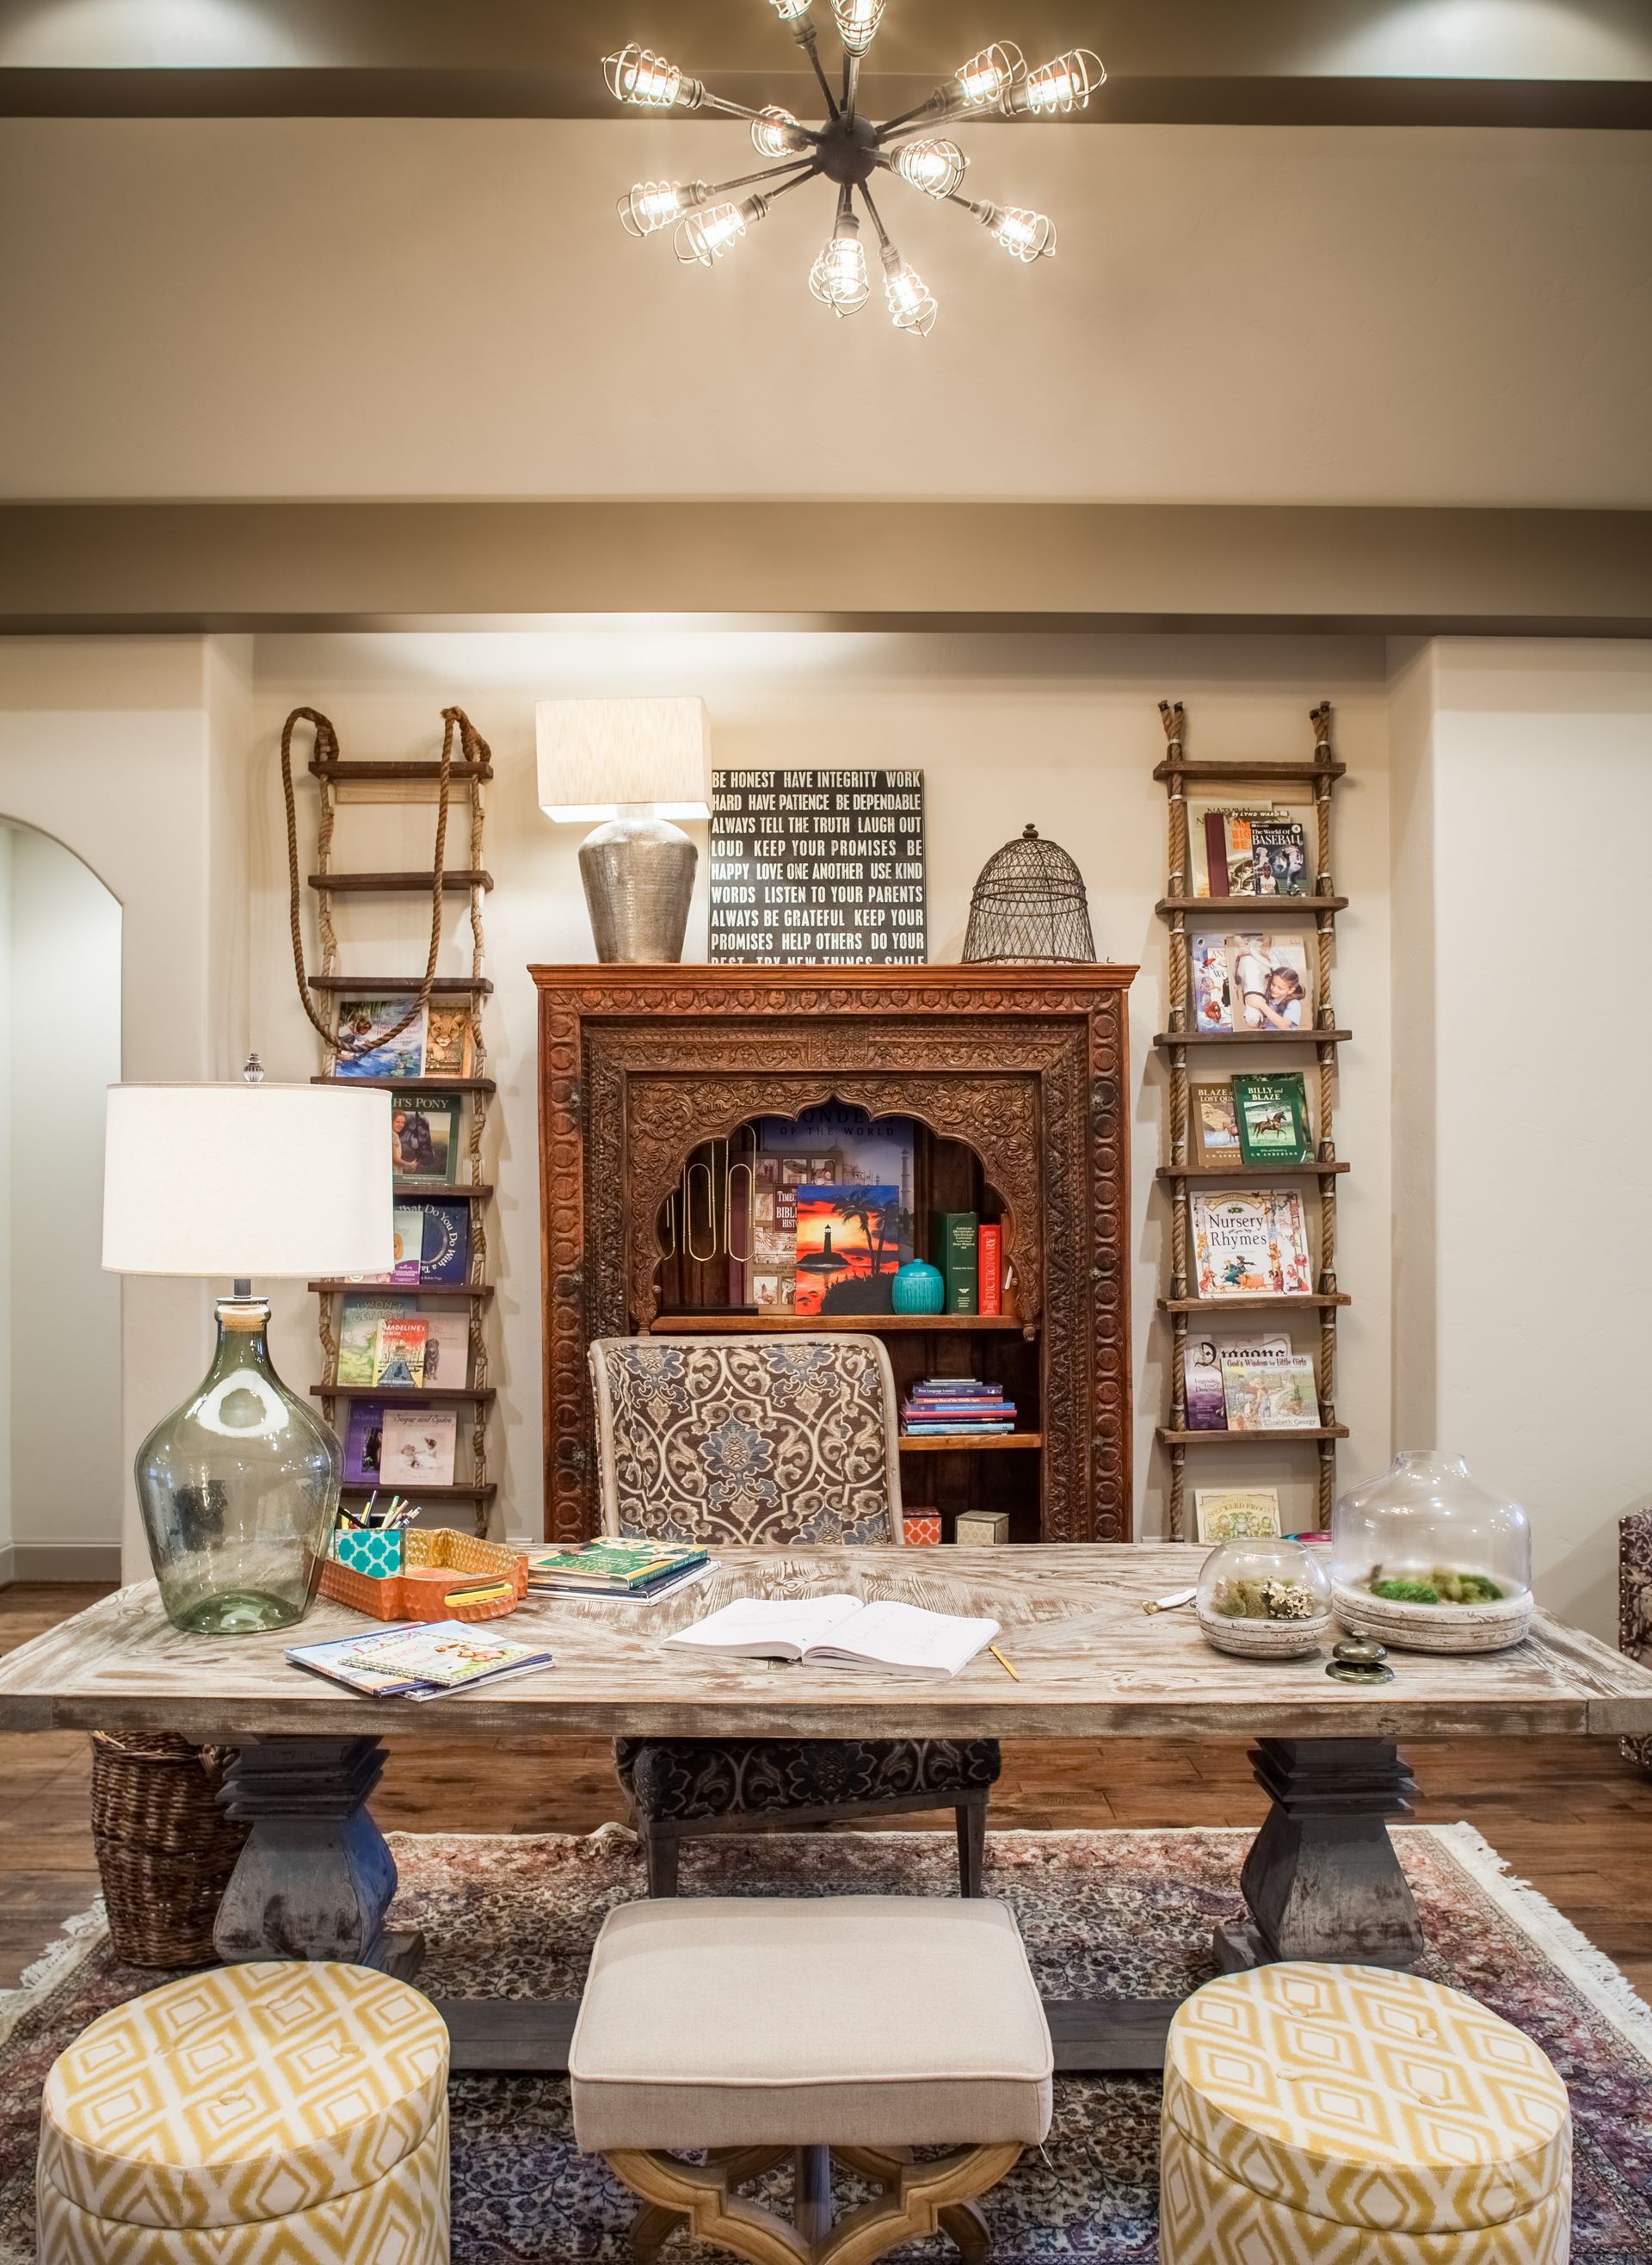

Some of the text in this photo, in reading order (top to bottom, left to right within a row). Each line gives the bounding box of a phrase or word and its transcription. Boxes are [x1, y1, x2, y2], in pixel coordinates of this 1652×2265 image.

[712, 772, 921, 788] BE HONEST HAVE INTEGRITY WORK
[712, 794, 921, 811] HARD HAVE PATIENCE BE DEPENDABLE
[712, 818, 922, 833] ALWAYS TELL THE TRUTH LAUGH OUT
[712, 840, 922, 856] LOUD KEEP YOUR PROMISES BE
[1252, 835, 1304, 845] BASEBALL
[711, 863, 922, 879] HAPPY LOVE ONE ANOTHER USE KIND
[711, 886, 923, 904] WORDS LISTEN TO YOUR PARENTS
[711, 910, 924, 927] ALWAYS BE GRATEFUL KEEP YOUR
[711, 933, 924, 950] PROMISES HELP OTHERS DO YOUR
[415, 1098, 448, 1108] PONY
[780, 1126, 894, 1136] OF THE WORLD
[777, 1191, 797, 1202] TIMEC
[425, 1204, 440, 1217] Do
[776, 1207, 798, 1219] BIBLI
[441, 1212, 453, 1231] You
[1208, 1213, 1264, 1231] Nursery
[449, 1232, 458, 1246] Do
[1211, 1231, 1267, 1250] Rhymes
[438, 1250, 456, 1267] With
[985, 1237, 996, 1299] DICTIONARY
[352, 1311, 375, 1323] GET
[1276, 1358, 1291, 1367] Little
[1292, 1357, 1308, 1367] Girls
[394, 1414, 452, 1425] Sugar and Spice
